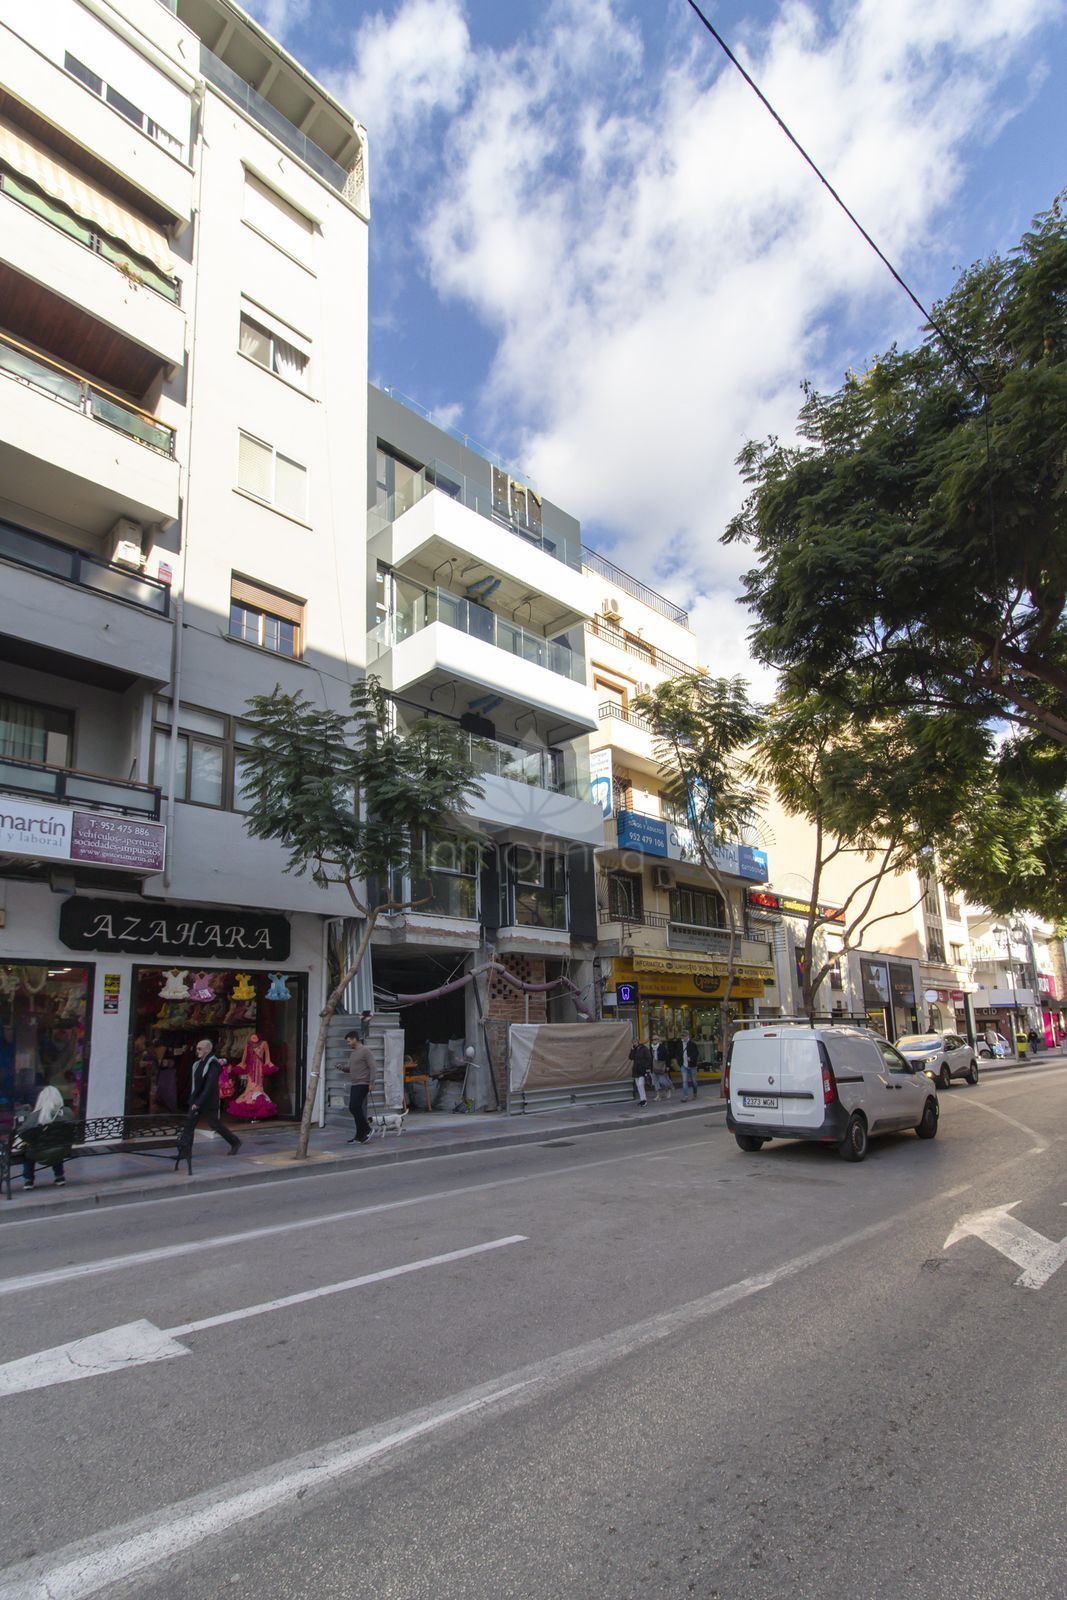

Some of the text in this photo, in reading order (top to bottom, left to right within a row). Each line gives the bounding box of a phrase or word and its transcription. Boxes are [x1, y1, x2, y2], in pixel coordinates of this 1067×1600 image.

[0, 814, 66, 837] martín
[100, 821, 115, 831] 952
[117, 824, 132, 834] 475
[134, 827, 150, 837] 886
[7, 831, 63, 847] y laboral
[629, 832, 641, 842] 952
[642, 835, 653, 845] 479
[82, 914, 273, 950] AZAHARA
[746, 1096, 761, 1106] 2373
